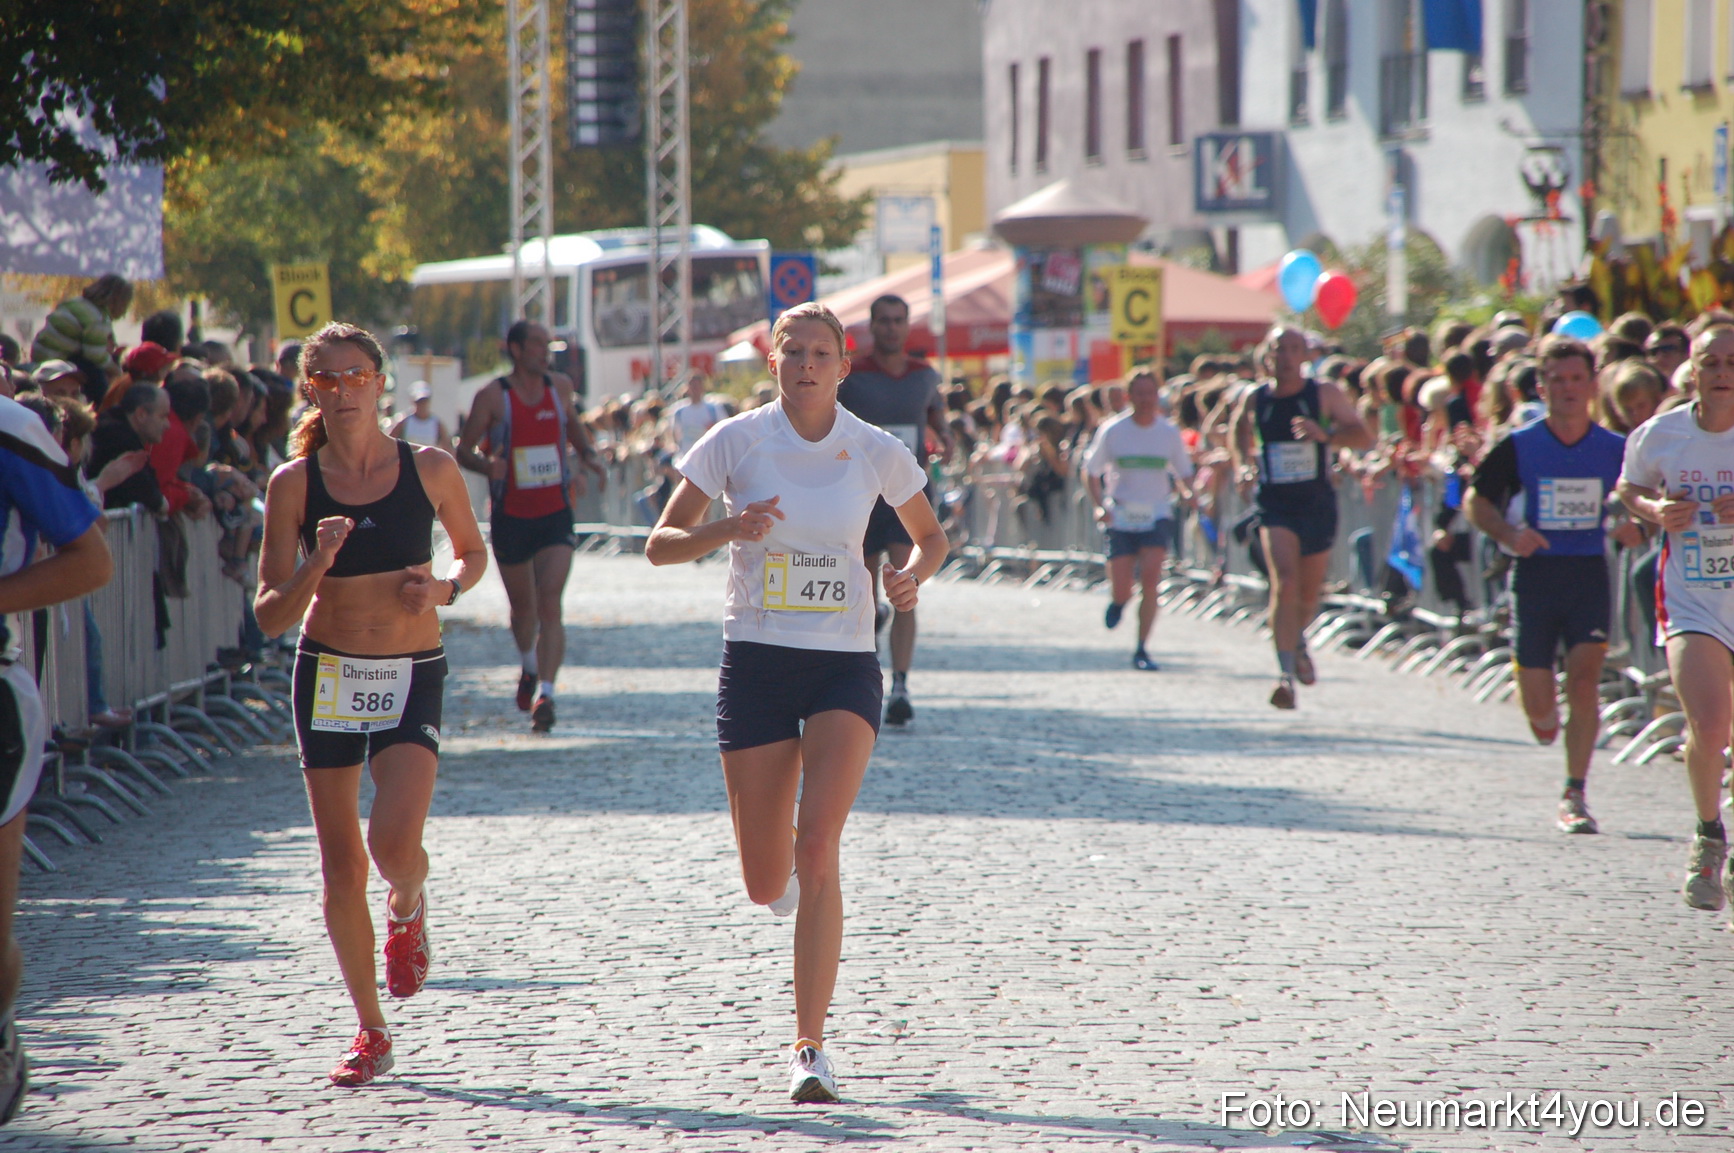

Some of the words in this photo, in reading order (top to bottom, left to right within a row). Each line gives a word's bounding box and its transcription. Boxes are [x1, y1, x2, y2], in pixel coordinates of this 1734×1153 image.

[289, 288, 318, 328] C
[1124, 287, 1150, 327] C
[792, 554, 837, 568] Claudia
[769, 573, 775, 584] A
[800, 580, 846, 601] 478
[343, 664, 397, 680] Christine
[319, 683, 326, 694] A
[351, 691, 395, 712] 586
